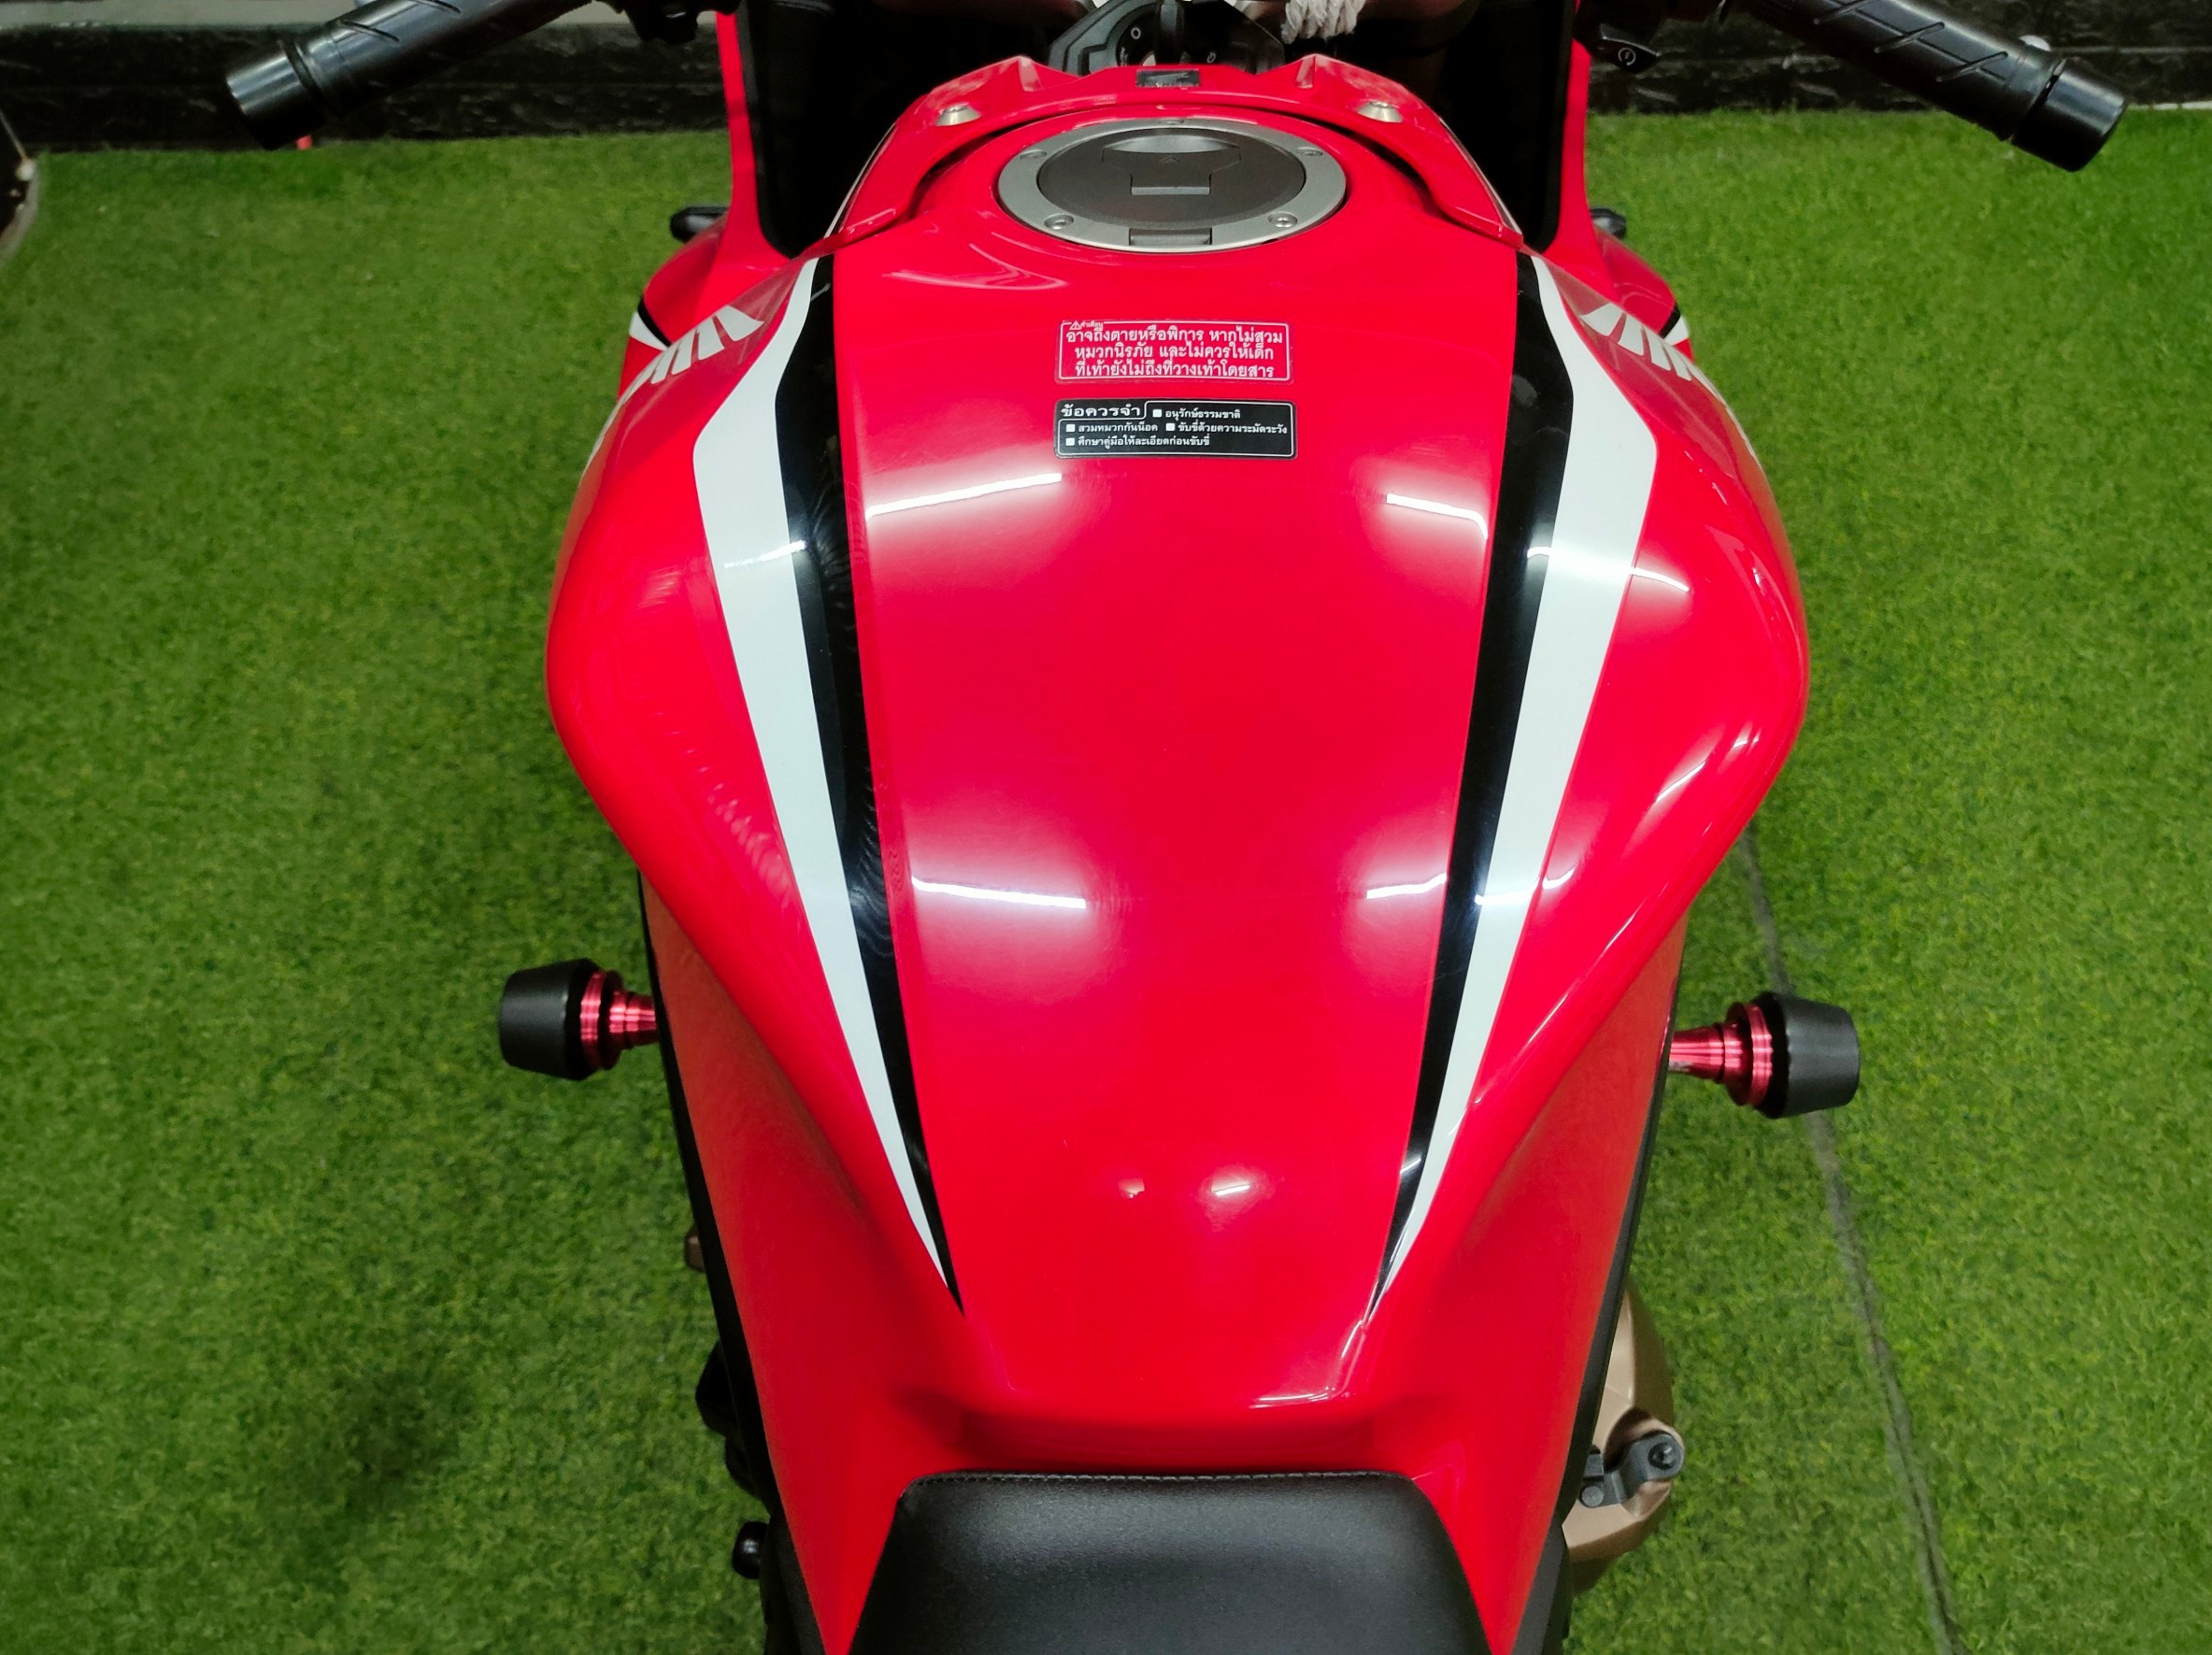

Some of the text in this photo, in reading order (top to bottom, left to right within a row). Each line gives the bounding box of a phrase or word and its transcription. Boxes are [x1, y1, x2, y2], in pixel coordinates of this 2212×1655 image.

[1066, 325, 1282, 344] อาจถึงตายหรือพิการ หากไม่สวม
[1075, 341, 1274, 359] หมวกนิรภัย และไม่ควรให้เด็ก
[1061, 404, 1140, 417] ข้อควรจำ
[1165, 407, 1241, 421] อนุรักษ์ธรรมชาติ
